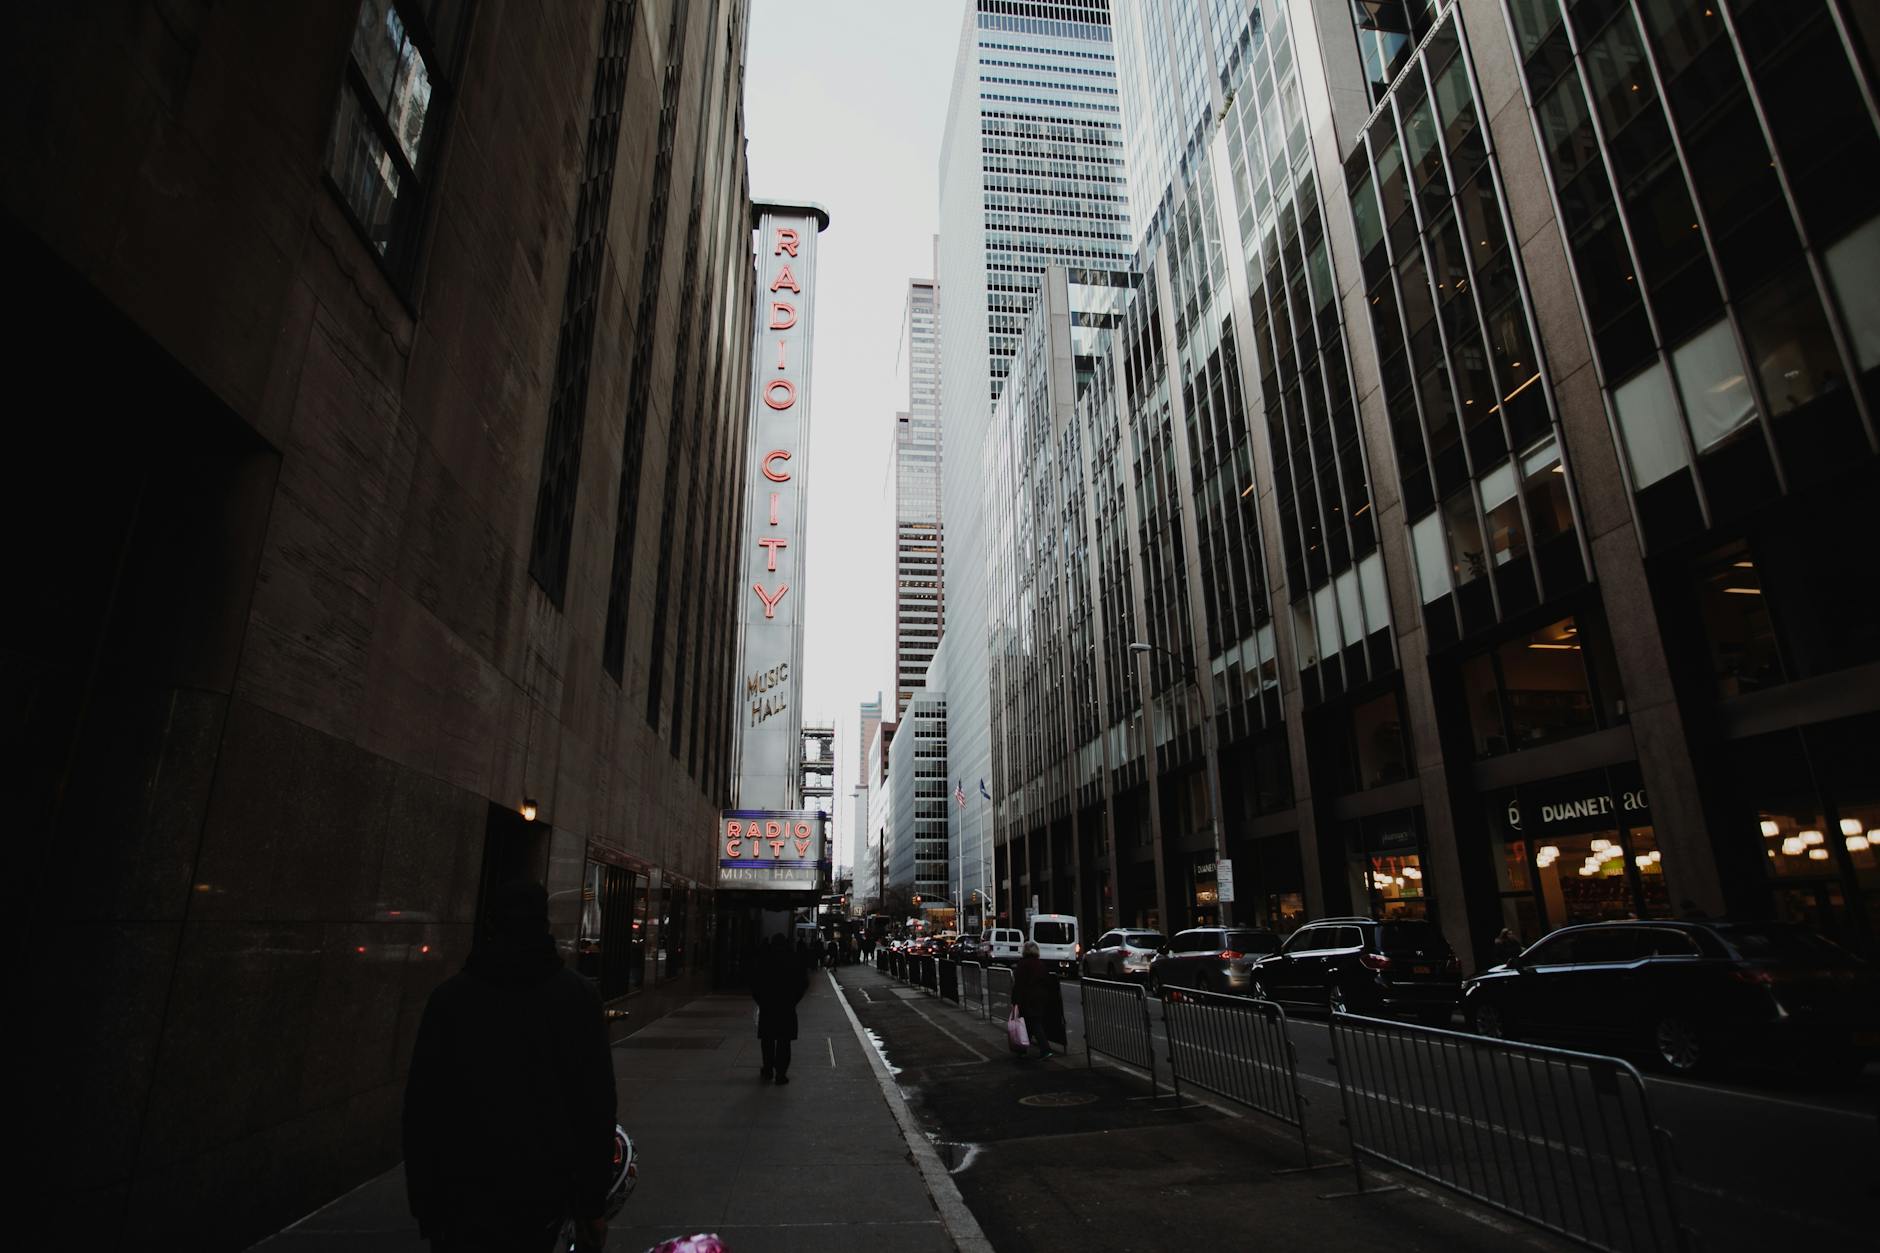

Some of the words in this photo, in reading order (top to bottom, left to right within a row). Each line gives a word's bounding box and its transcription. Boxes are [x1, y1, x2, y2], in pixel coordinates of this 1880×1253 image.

[763, 227, 801, 411] RADIO
[753, 448, 792, 620] CITY
[746, 663, 789, 703] MUSIC
[750, 691, 788, 728] HALL
[725, 838, 811, 858] CITY
[726, 820, 812, 840] RADIO
[721, 868, 769, 881] MUSI
[774, 868, 812, 881] HA
